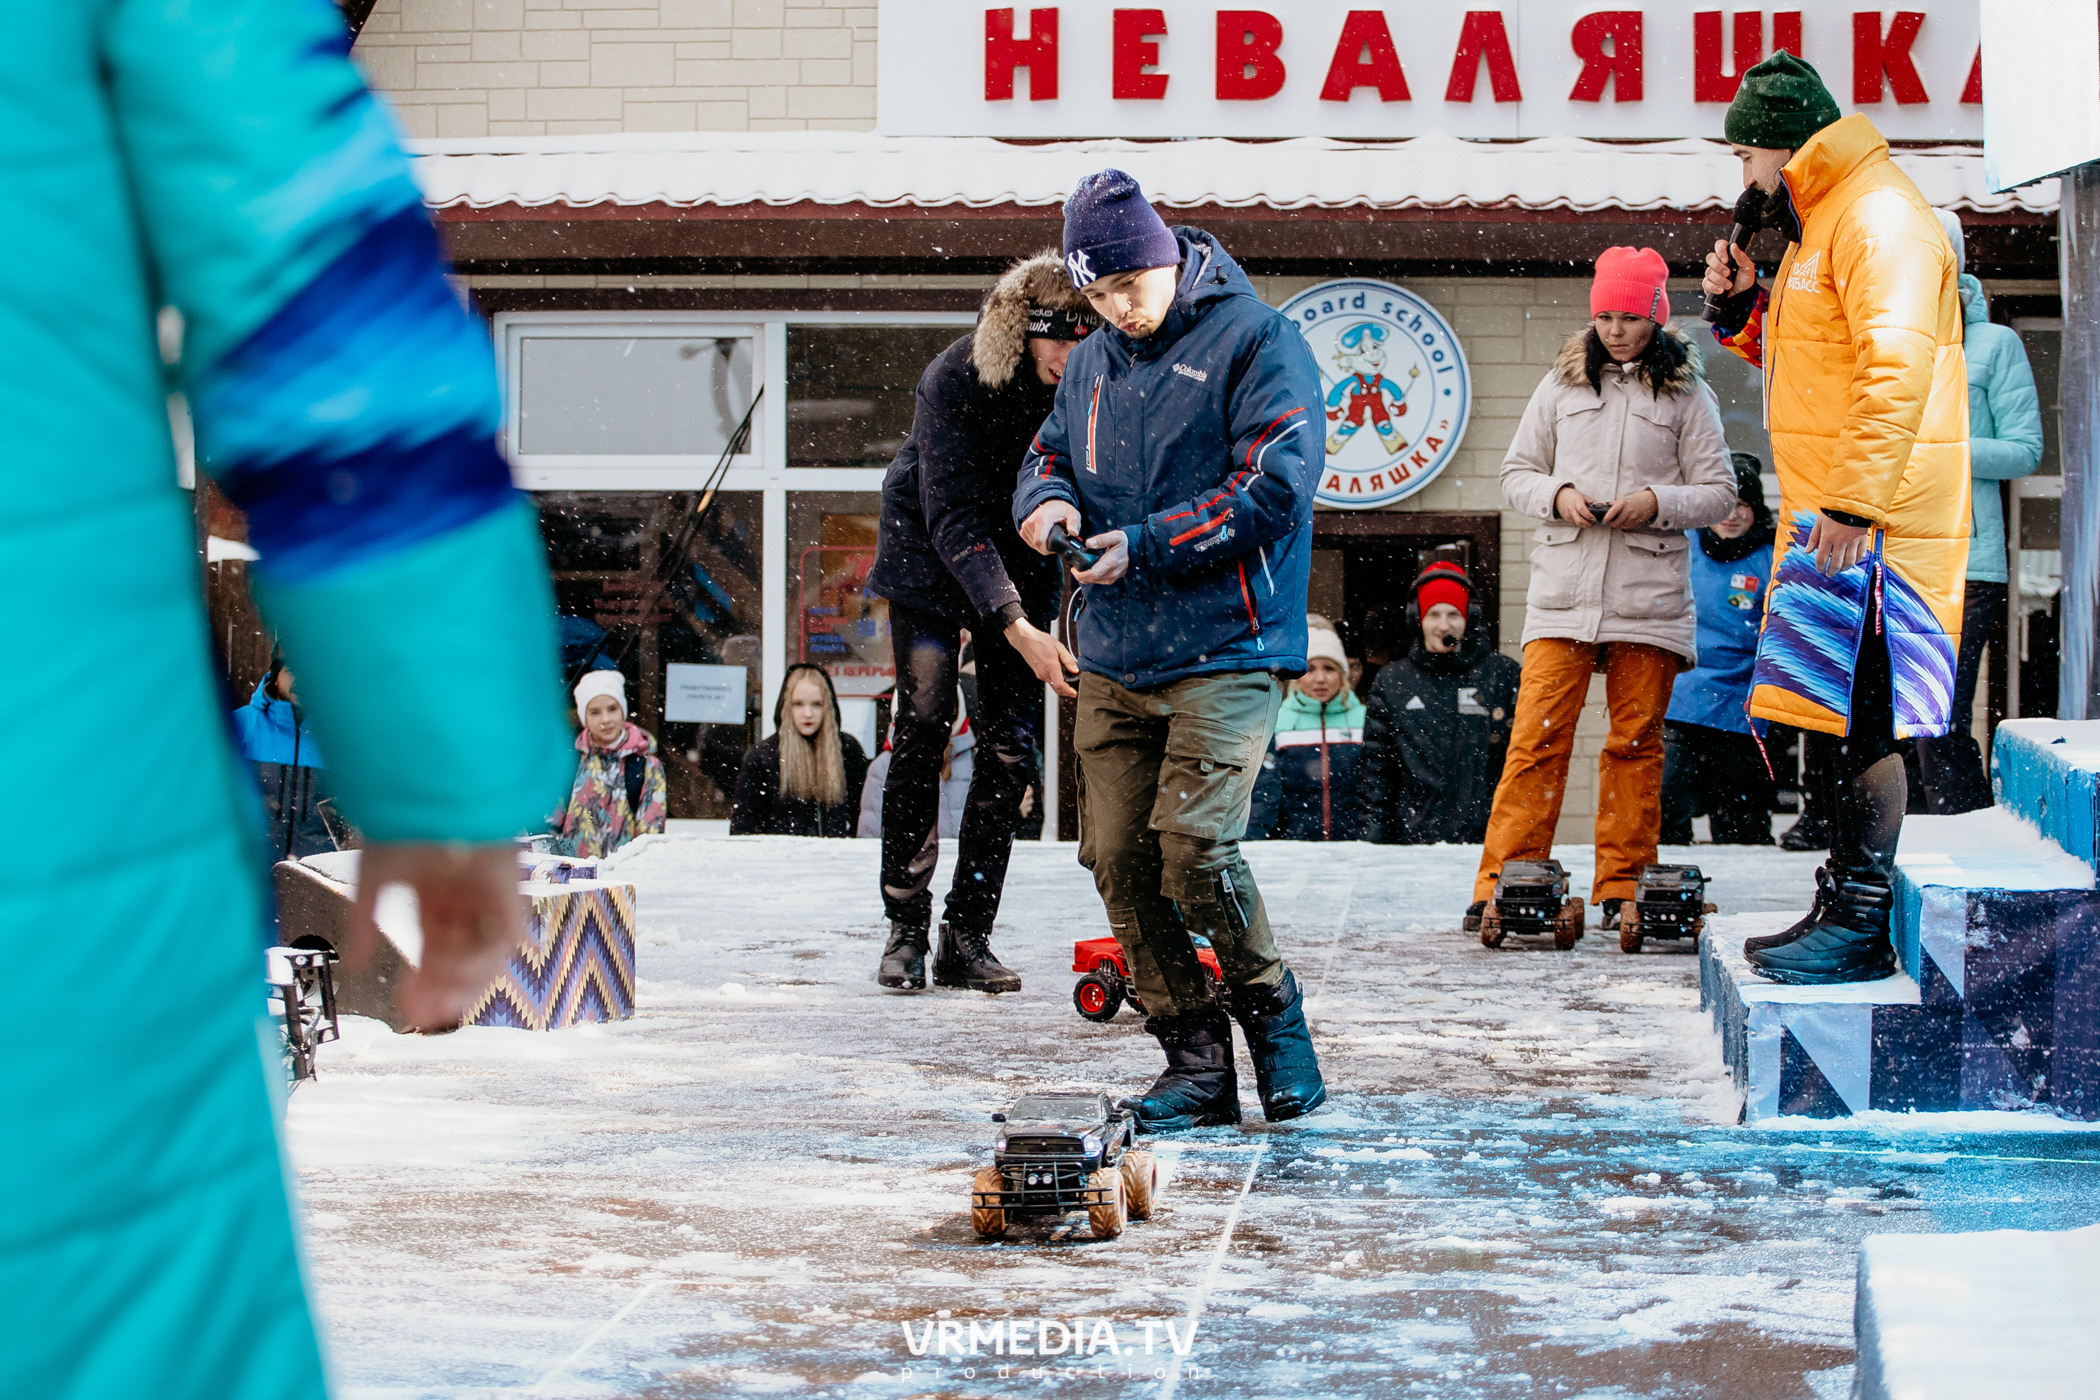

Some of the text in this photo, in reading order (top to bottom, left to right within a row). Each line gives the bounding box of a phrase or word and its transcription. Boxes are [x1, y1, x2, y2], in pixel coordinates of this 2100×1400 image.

[1028, 318, 1053, 334] wix
[1381, 300, 1453, 375] school
[1325, 419, 1450, 494] АЛЯШКА»
